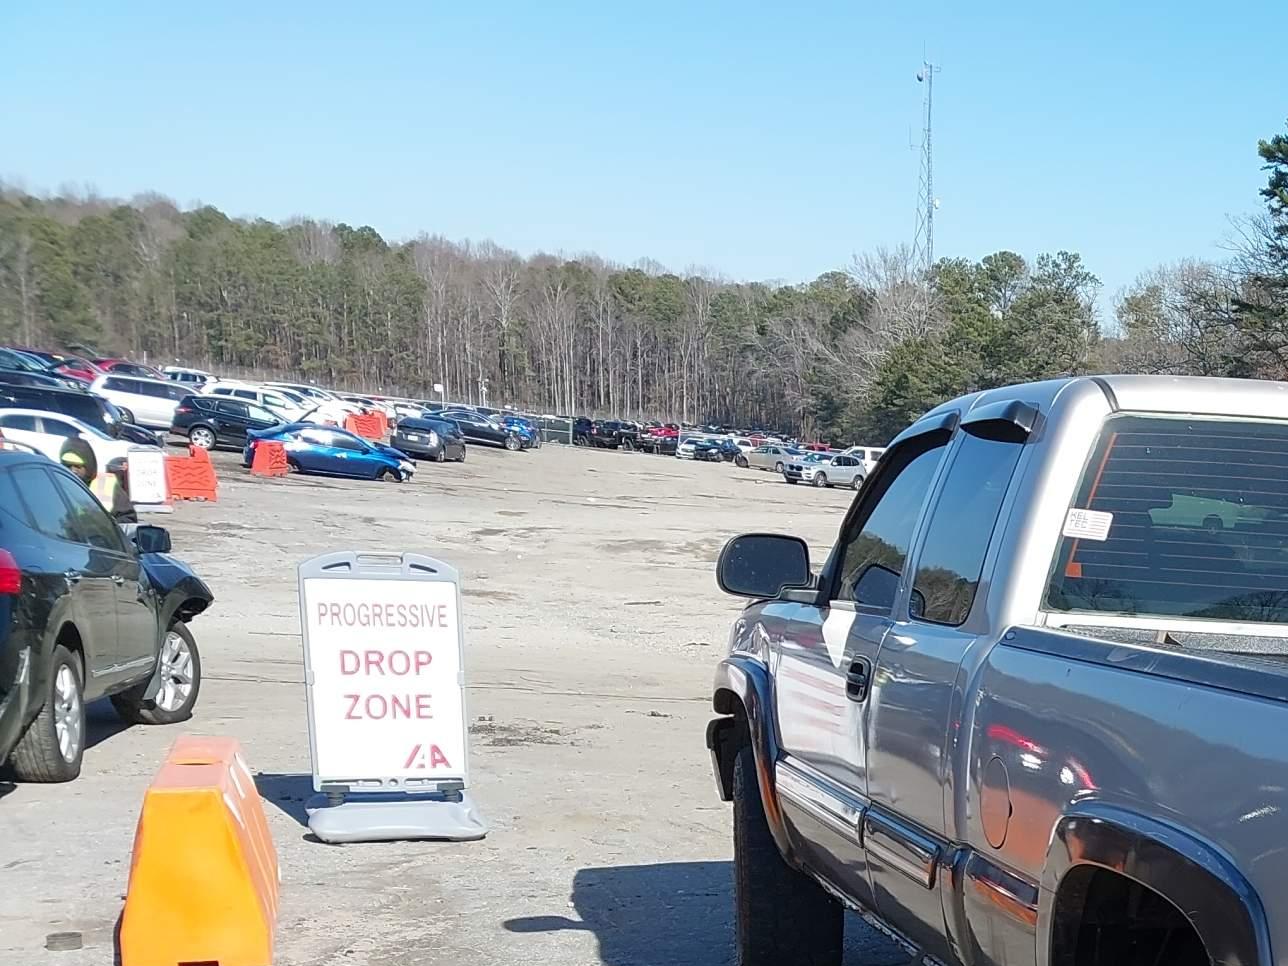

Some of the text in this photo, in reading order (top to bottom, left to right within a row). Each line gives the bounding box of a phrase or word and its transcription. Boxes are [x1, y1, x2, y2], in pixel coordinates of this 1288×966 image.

[1069, 519, 1088, 529] TEC
[1070, 511, 1089, 521] KEL
[317, 602, 448, 628] PROGRESSIVE
[339, 650, 433, 676] DROP
[344, 694, 434, 720] ZONE
